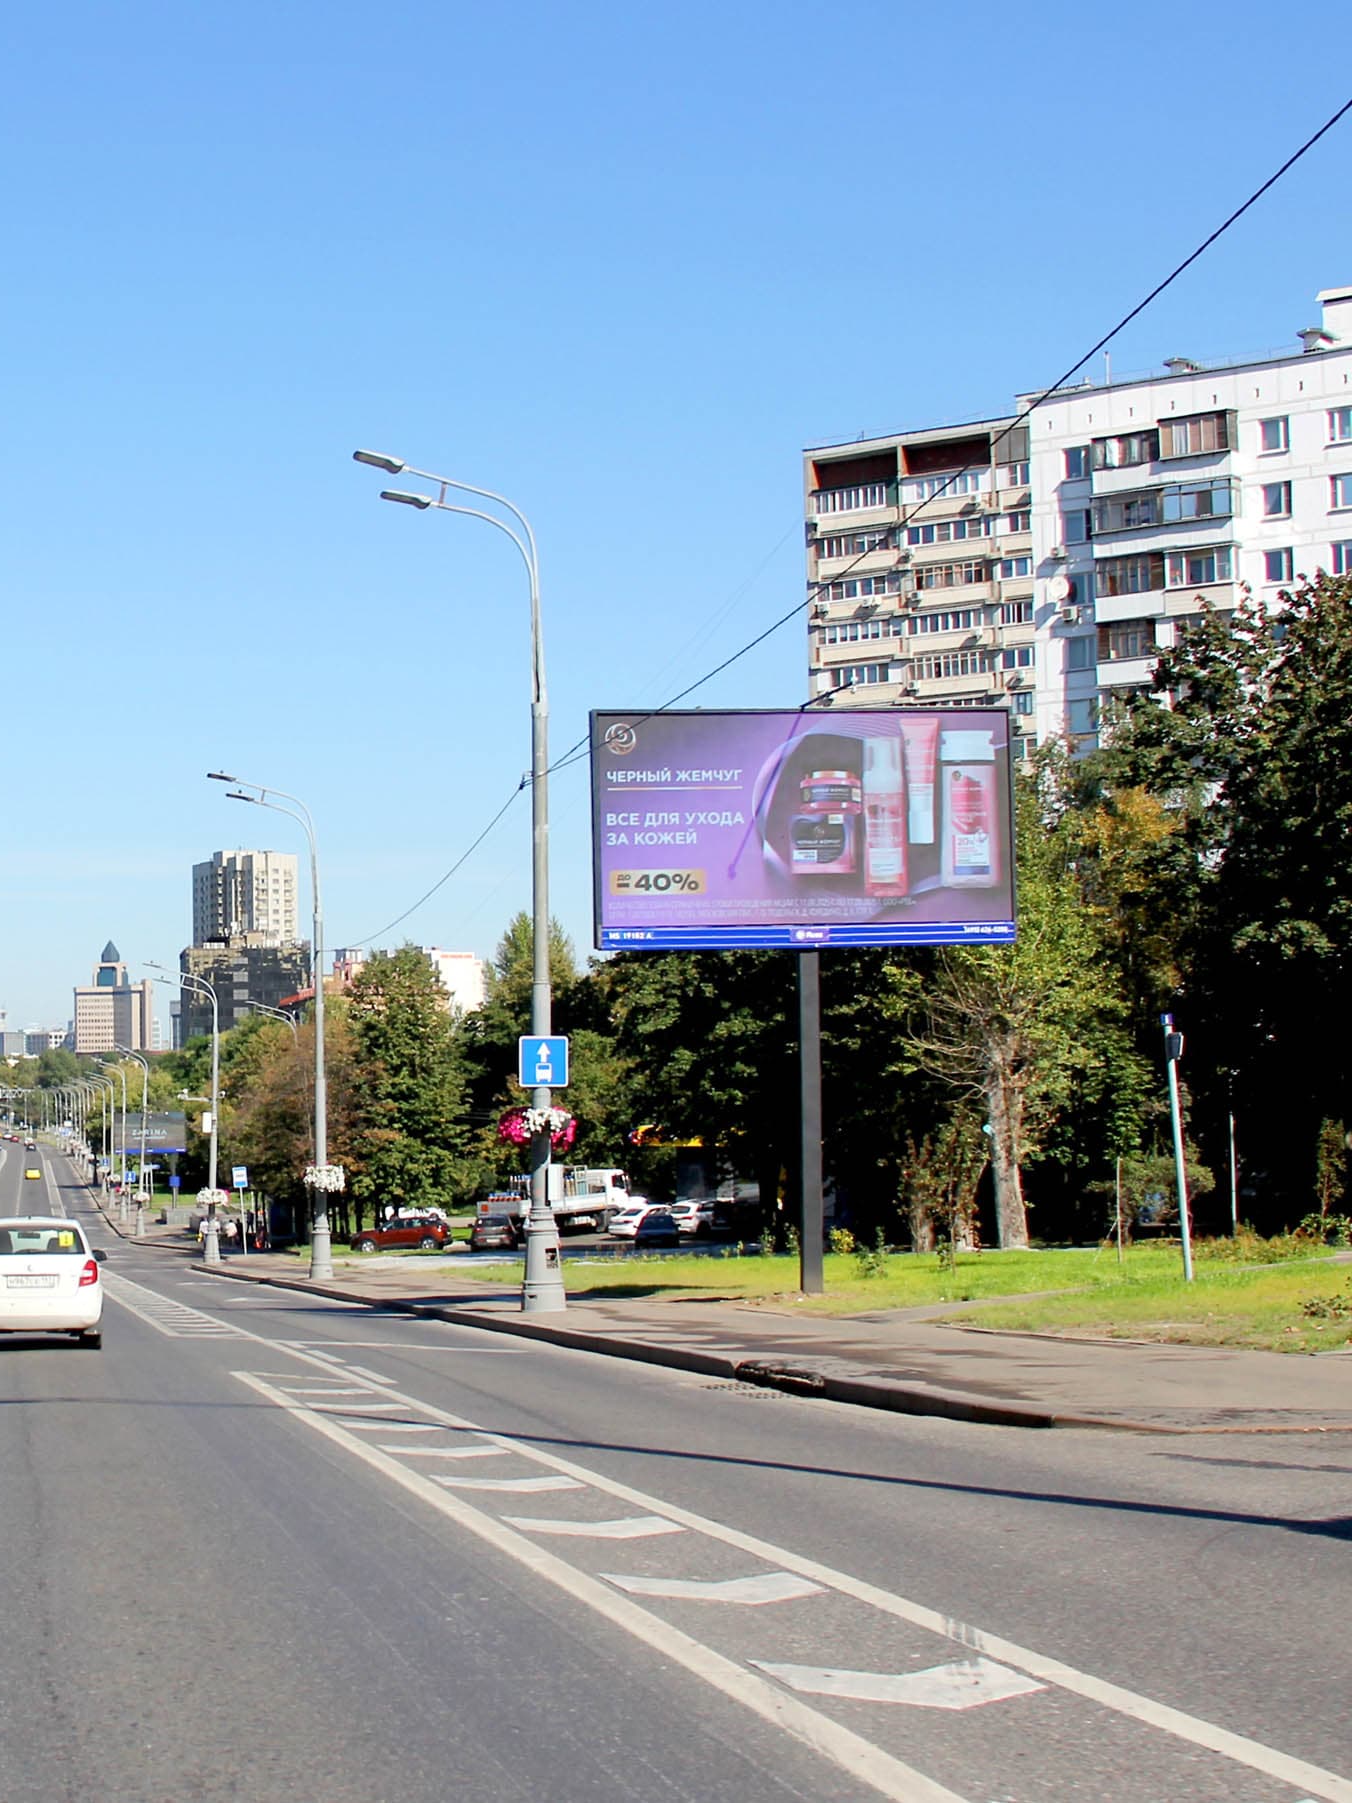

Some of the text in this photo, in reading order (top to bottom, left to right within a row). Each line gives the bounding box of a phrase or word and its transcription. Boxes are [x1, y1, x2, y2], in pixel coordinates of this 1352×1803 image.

[606, 768, 743, 783] ЧЕРНЫЙ ЖЕМЧУГ
[606, 811, 745, 827] ВСЕ ДЛЯ УХОДА
[606, 829, 697, 846] ЗА КОЖЕЙ
